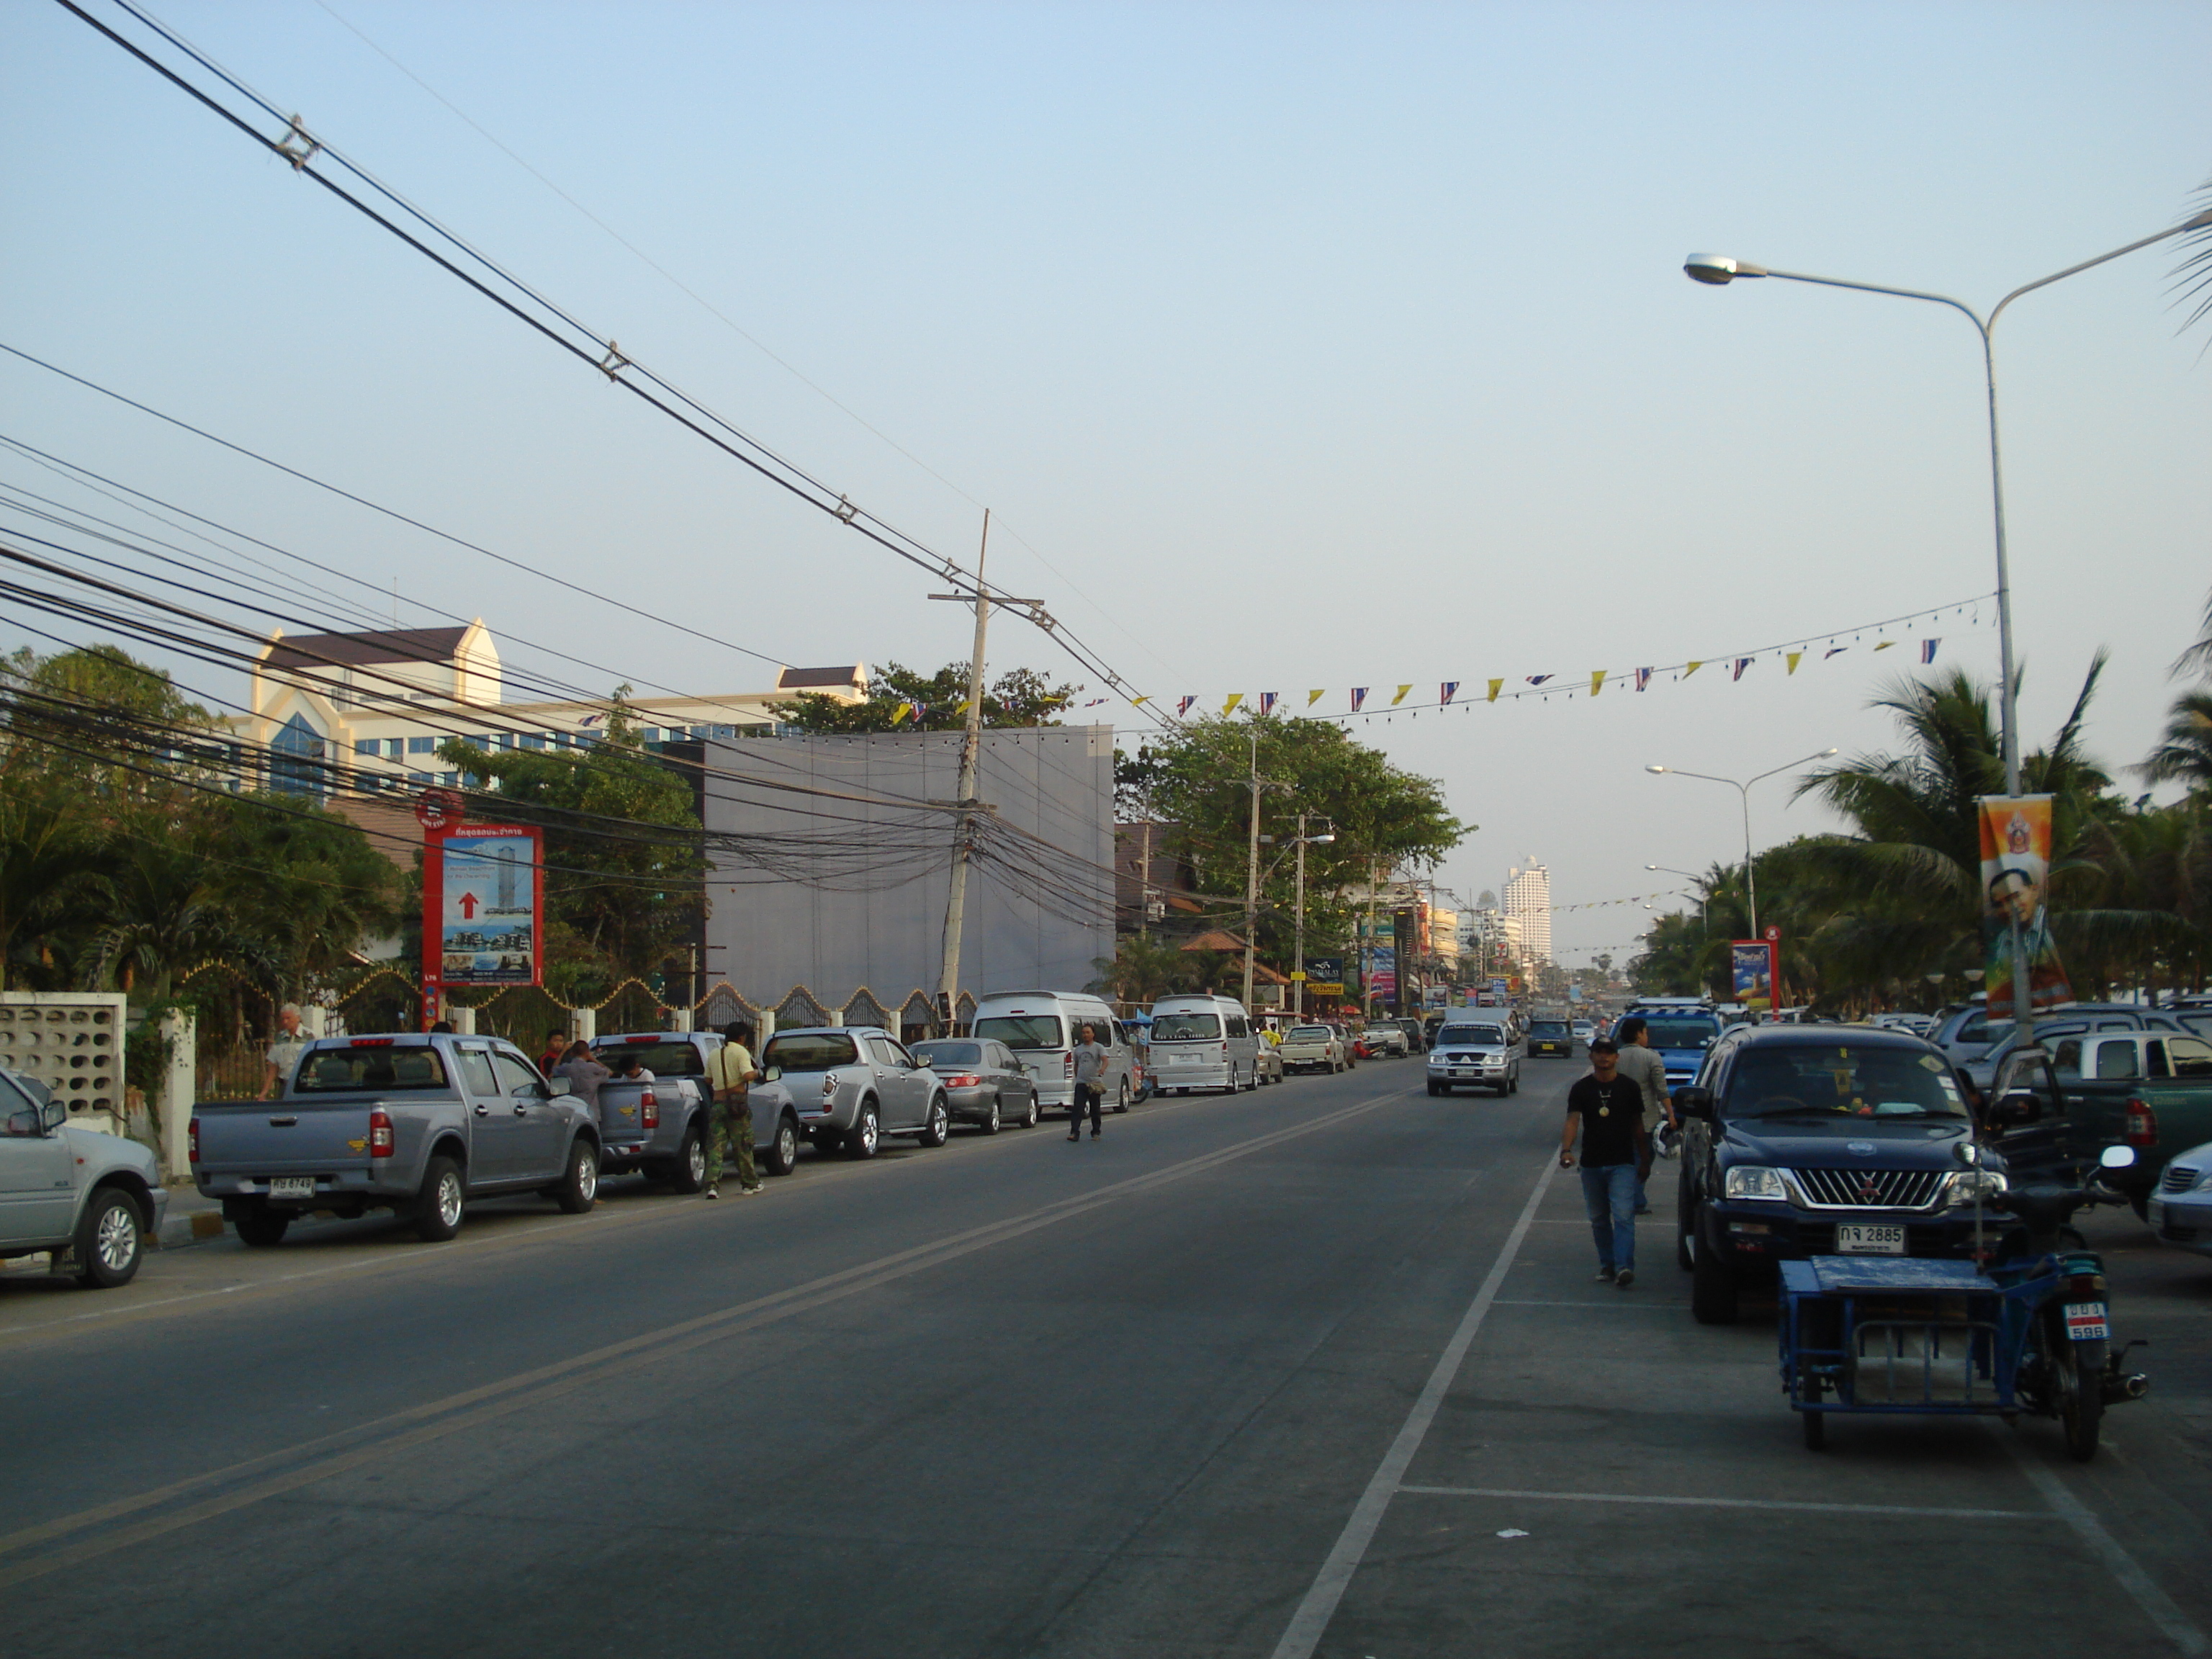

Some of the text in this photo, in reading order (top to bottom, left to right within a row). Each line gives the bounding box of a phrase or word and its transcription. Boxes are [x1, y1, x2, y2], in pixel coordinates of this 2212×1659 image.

[1841, 1227, 1901, 1242] กจ 2885
[2073, 1326, 2103, 1339] 596
